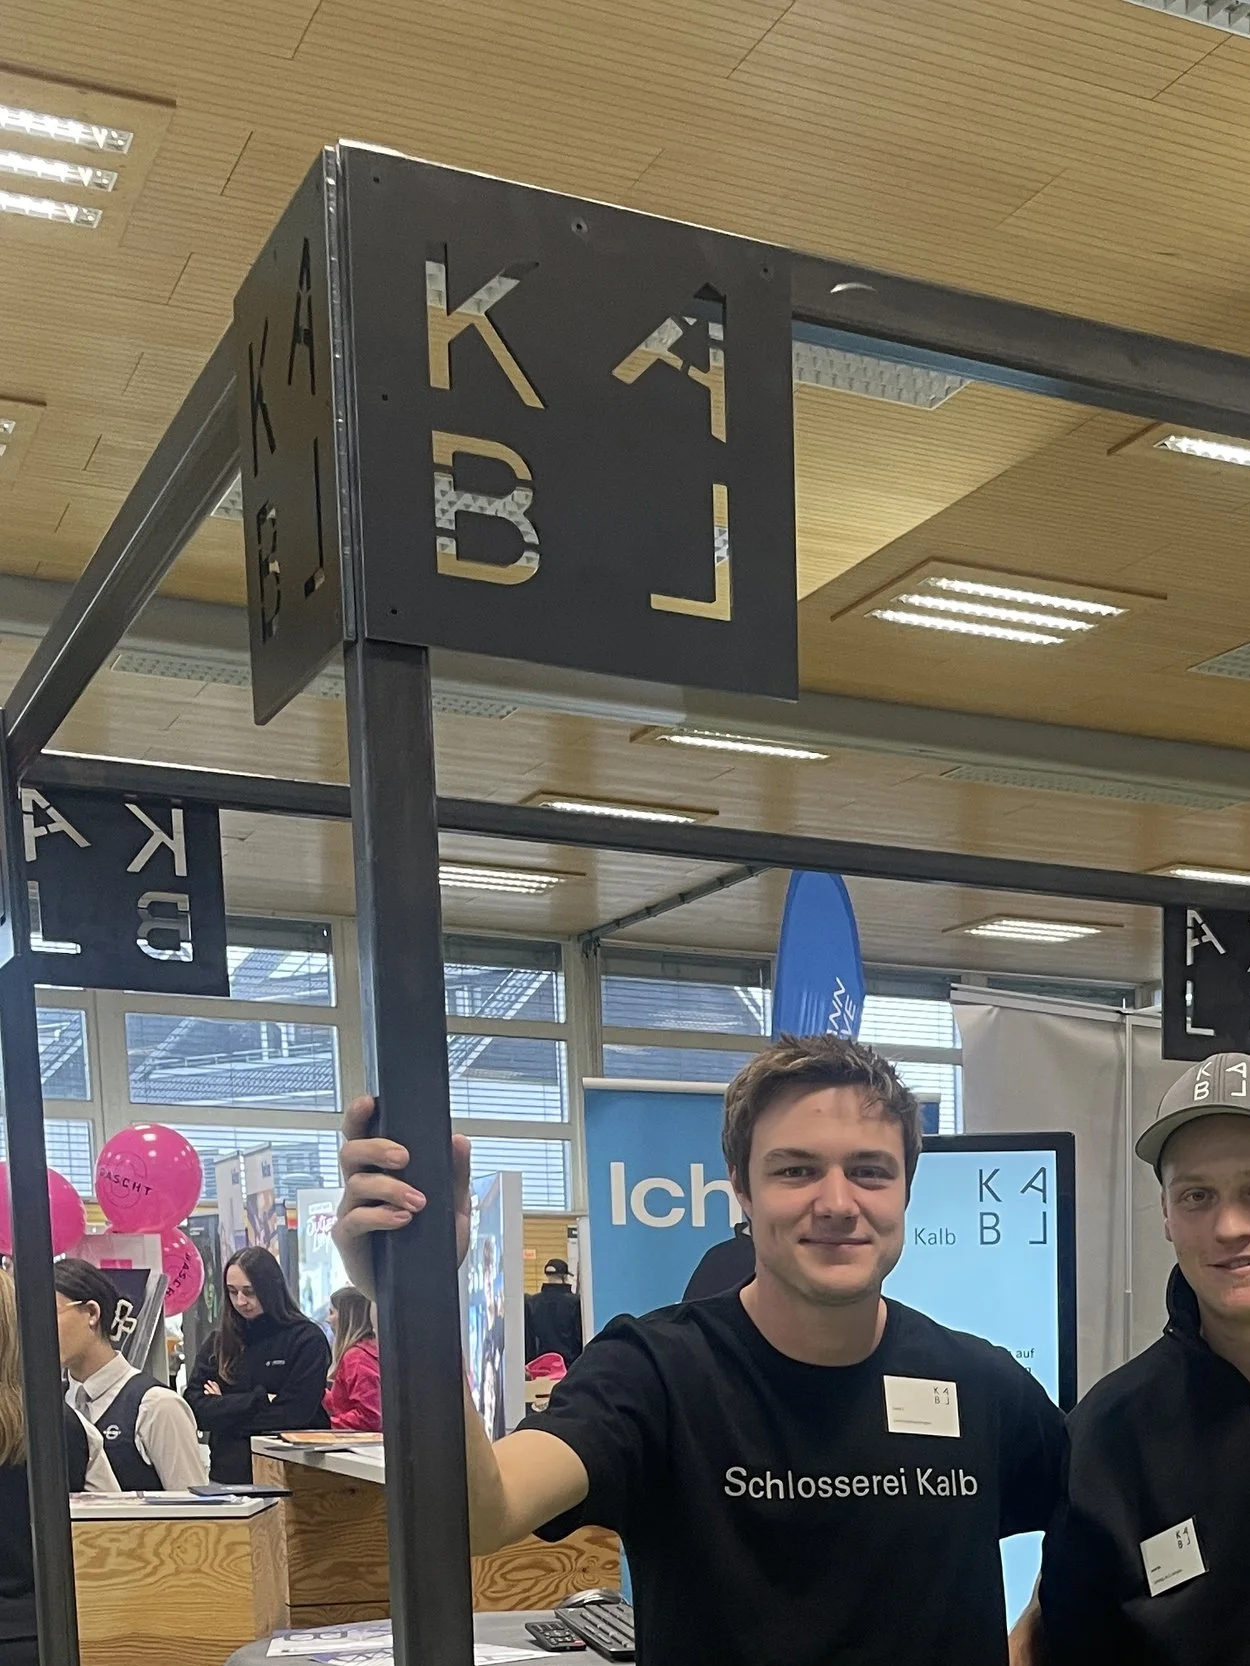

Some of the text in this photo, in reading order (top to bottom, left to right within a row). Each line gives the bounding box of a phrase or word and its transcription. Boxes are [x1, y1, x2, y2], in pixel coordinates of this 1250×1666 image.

[609, 1161, 743, 1228] Ich
[913, 1227, 957, 1246] Kalb
[1015, 1347, 1035, 1359] auf
[723, 1466, 979, 1500] Schlosserei Kalb
